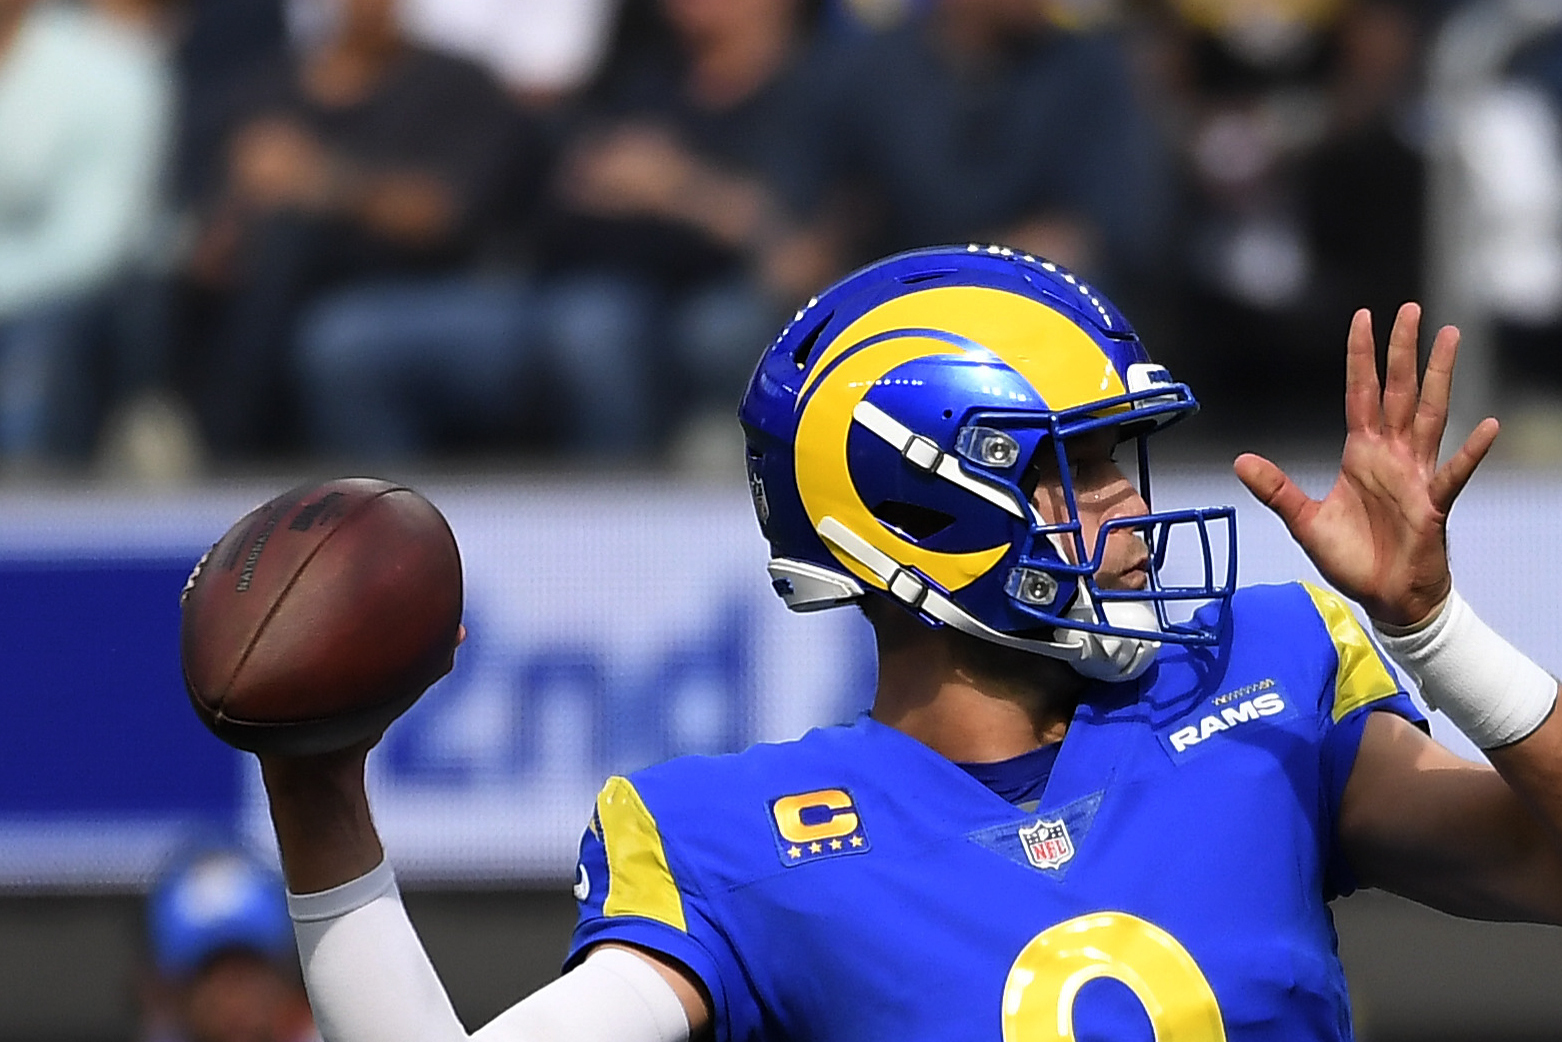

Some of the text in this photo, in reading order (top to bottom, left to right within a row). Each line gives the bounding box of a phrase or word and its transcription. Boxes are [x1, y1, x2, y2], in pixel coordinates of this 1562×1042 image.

[1169, 692, 1286, 753] RAMS
[773, 788, 859, 843] C
[1032, 839, 1067, 861] NFL
